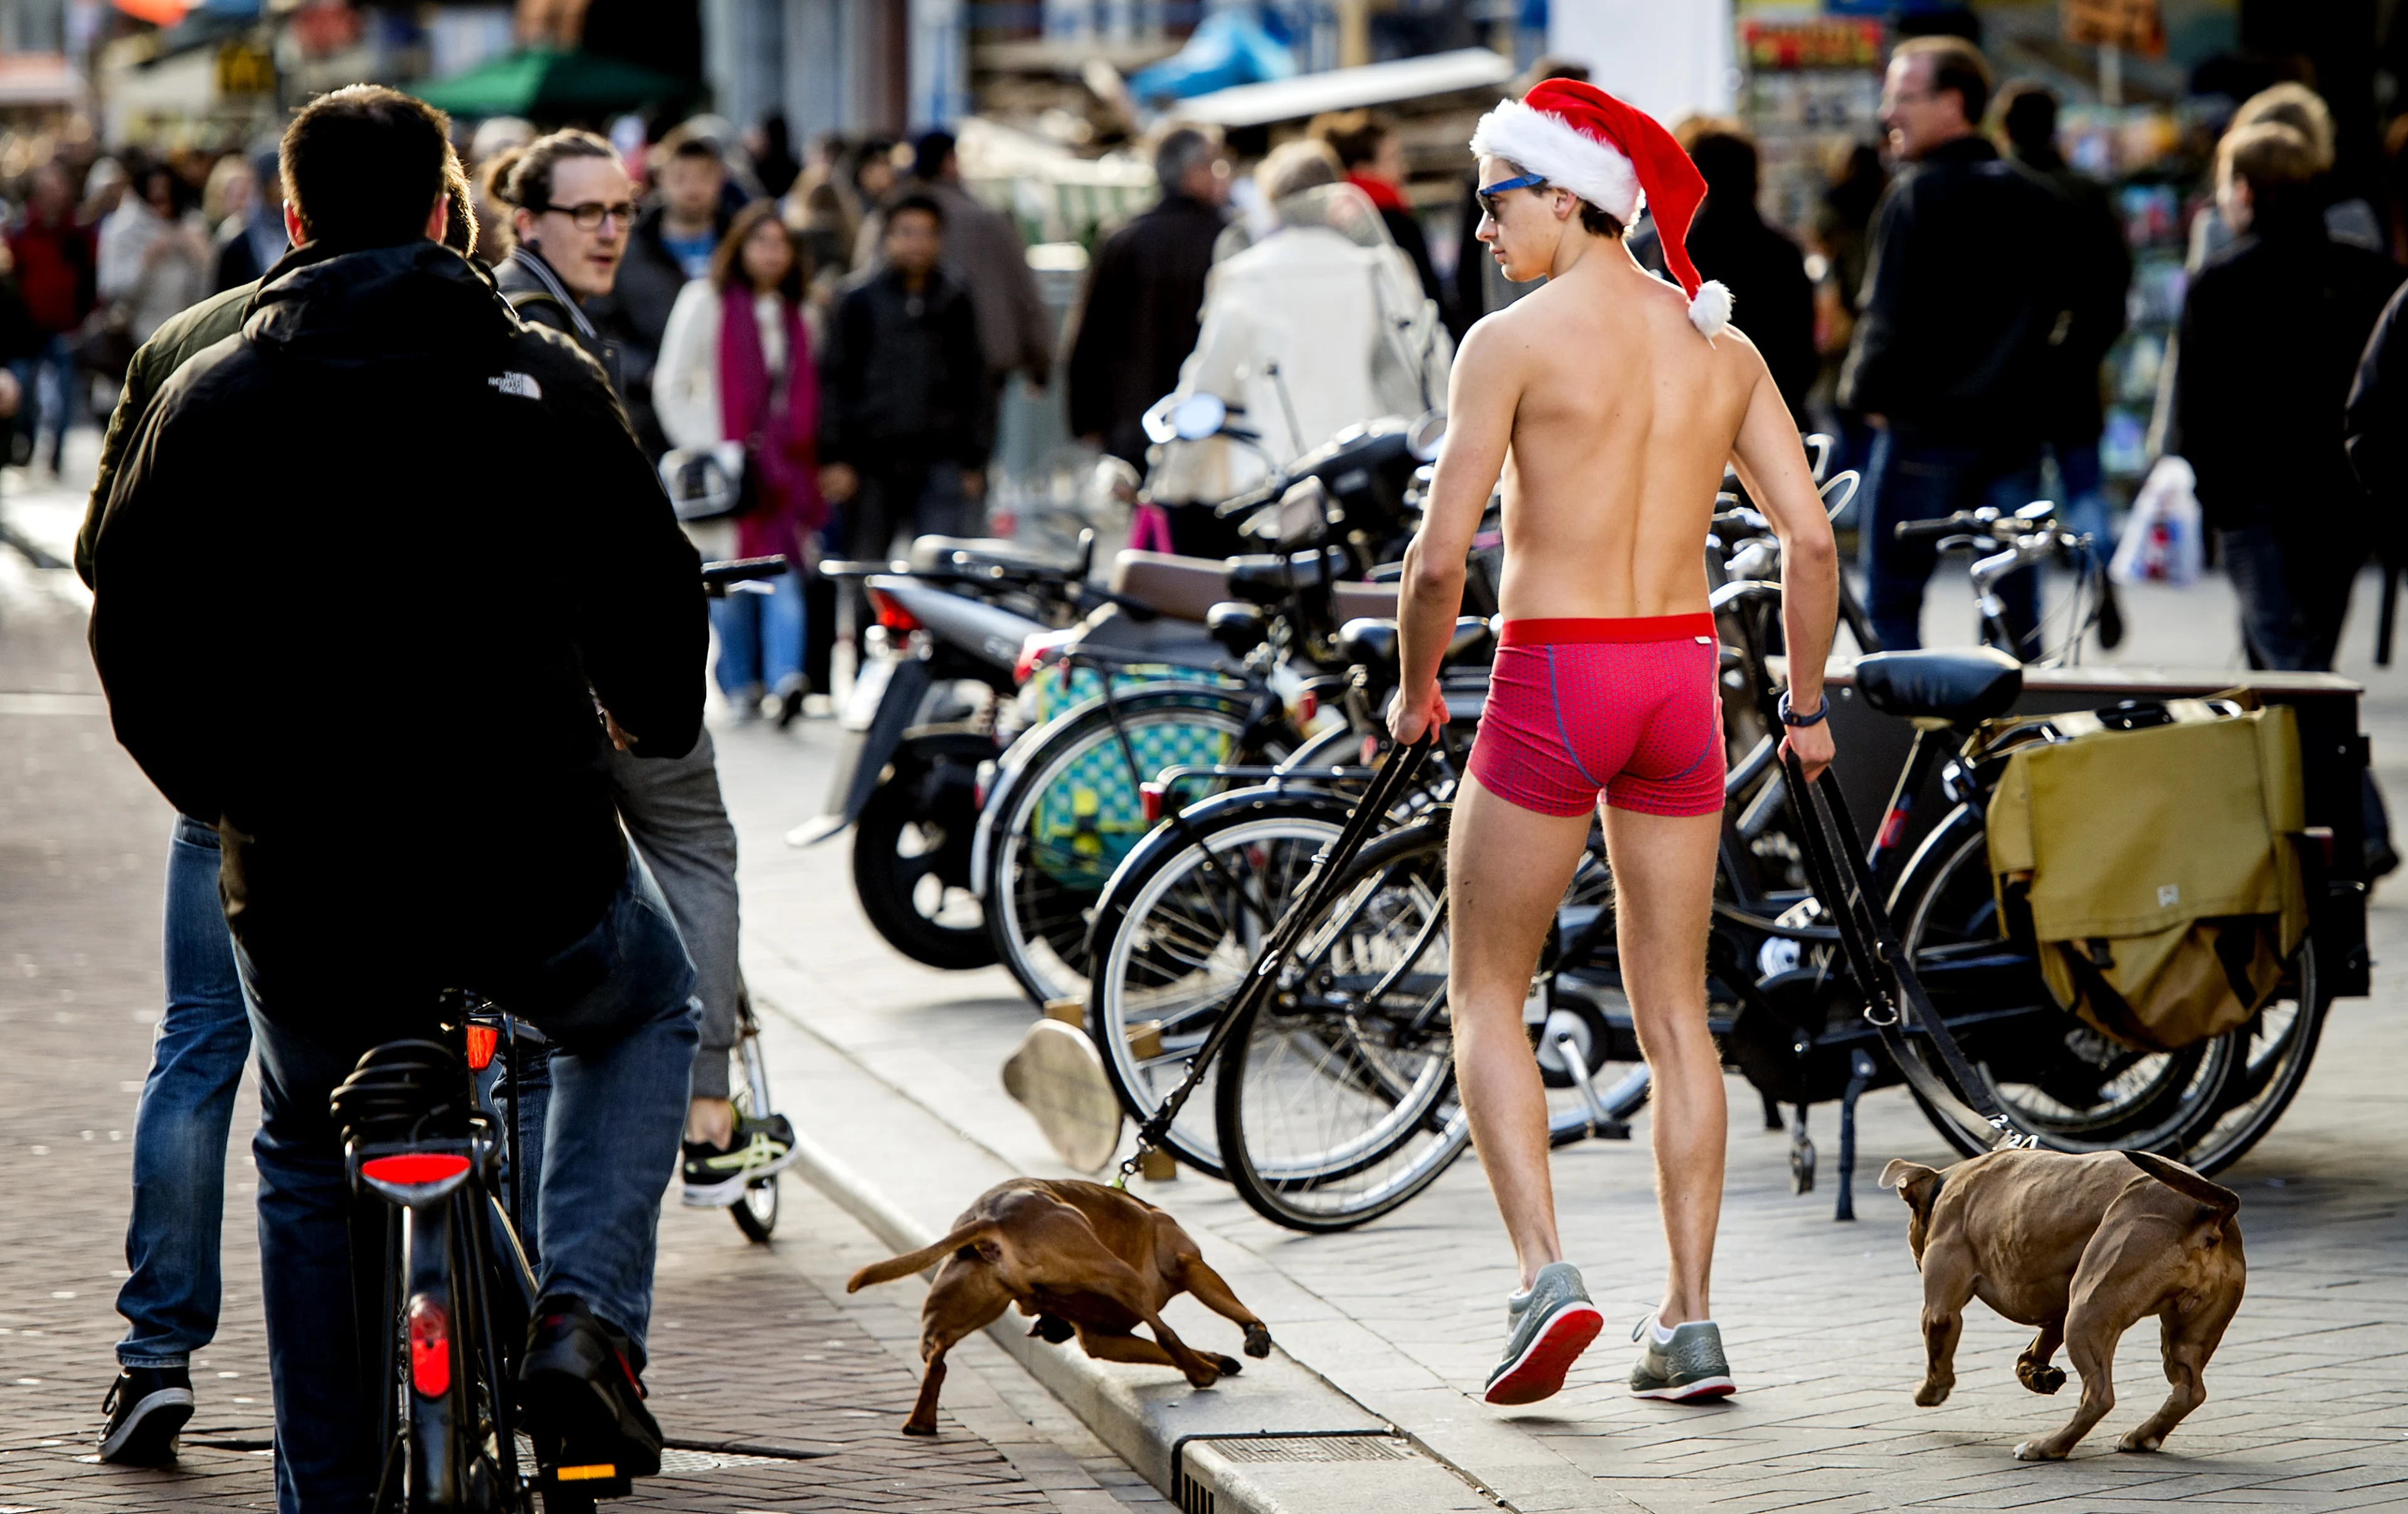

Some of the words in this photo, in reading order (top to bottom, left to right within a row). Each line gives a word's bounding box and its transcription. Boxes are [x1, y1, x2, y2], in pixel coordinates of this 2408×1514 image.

[503, 371, 522, 381] THE
[488, 376, 522, 387] NORTH
[499, 384, 522, 394] FACE
